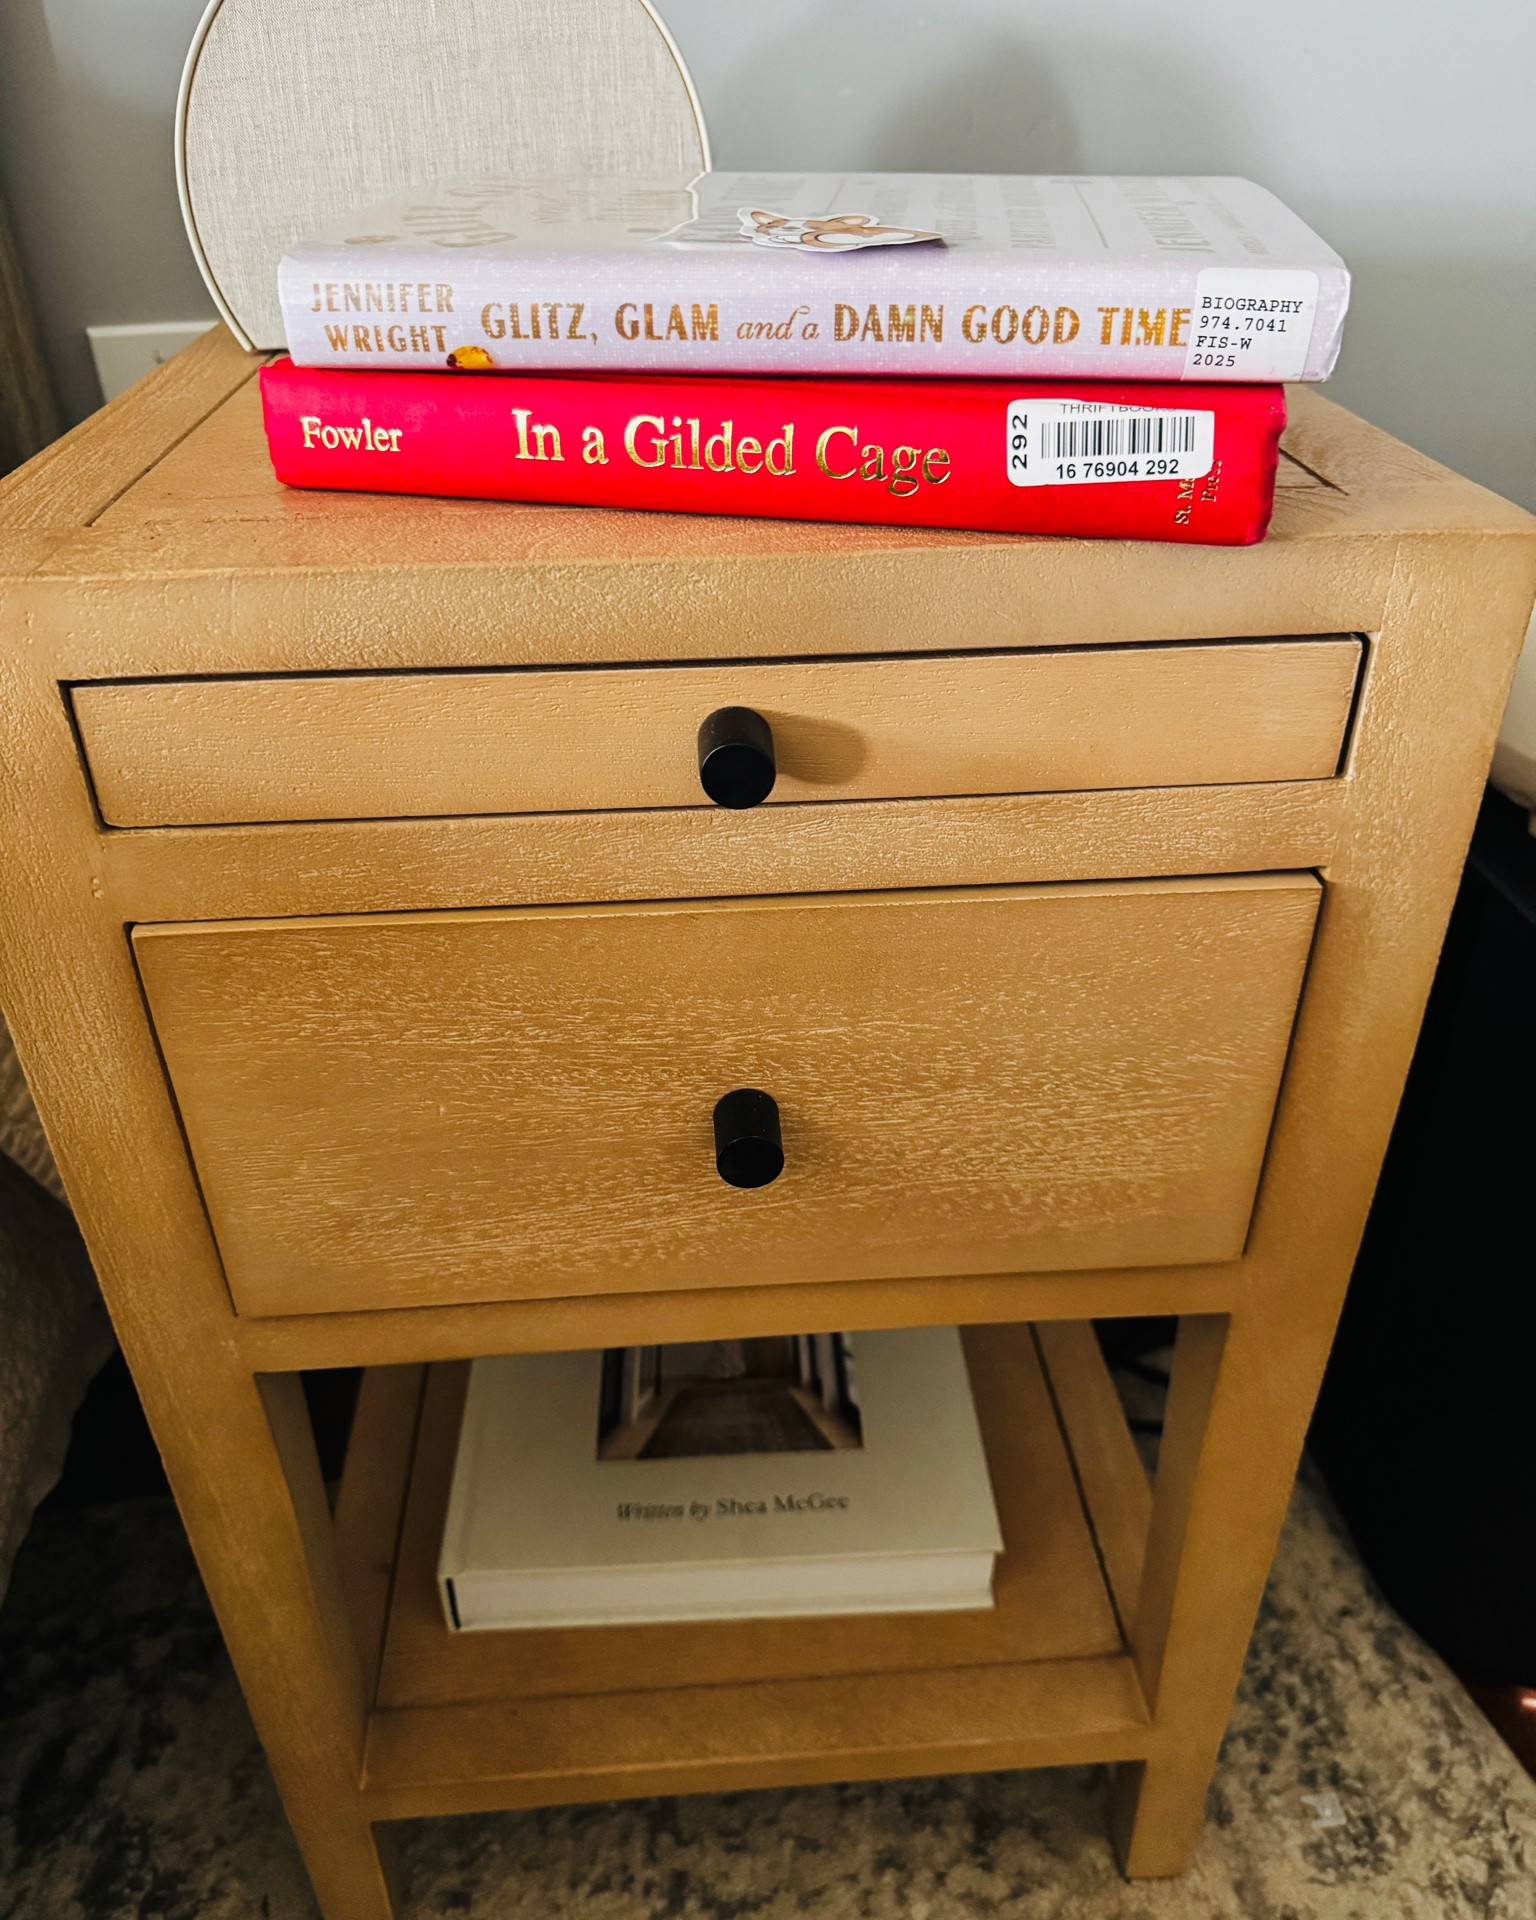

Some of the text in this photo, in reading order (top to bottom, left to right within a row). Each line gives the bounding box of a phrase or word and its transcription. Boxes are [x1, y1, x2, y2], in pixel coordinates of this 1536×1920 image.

[311, 282, 455, 314] JENNIFER
[1200, 296, 1304, 315] BIOGRAPHY
[323, 324, 448, 353] WRIGHT
[480, 302, 1193, 347] GLITZ, GLAM and a DAMN GOOD TIME
[1199, 315, 1288, 334] 974.7041
[1195, 335, 1253, 351] FIS-W
[1192, 353, 1237, 368] 2025
[300, 416, 403, 453] Fowler
[1011, 413, 1029, 470] 292
[511, 408, 952, 497] In a Gilded Cage
[1056, 458, 1180, 479] 16 76904 292
[689, 1500, 713, 1521] by
[716, 1497, 768, 1516] Shea
[774, 1492, 851, 1512] McGee
